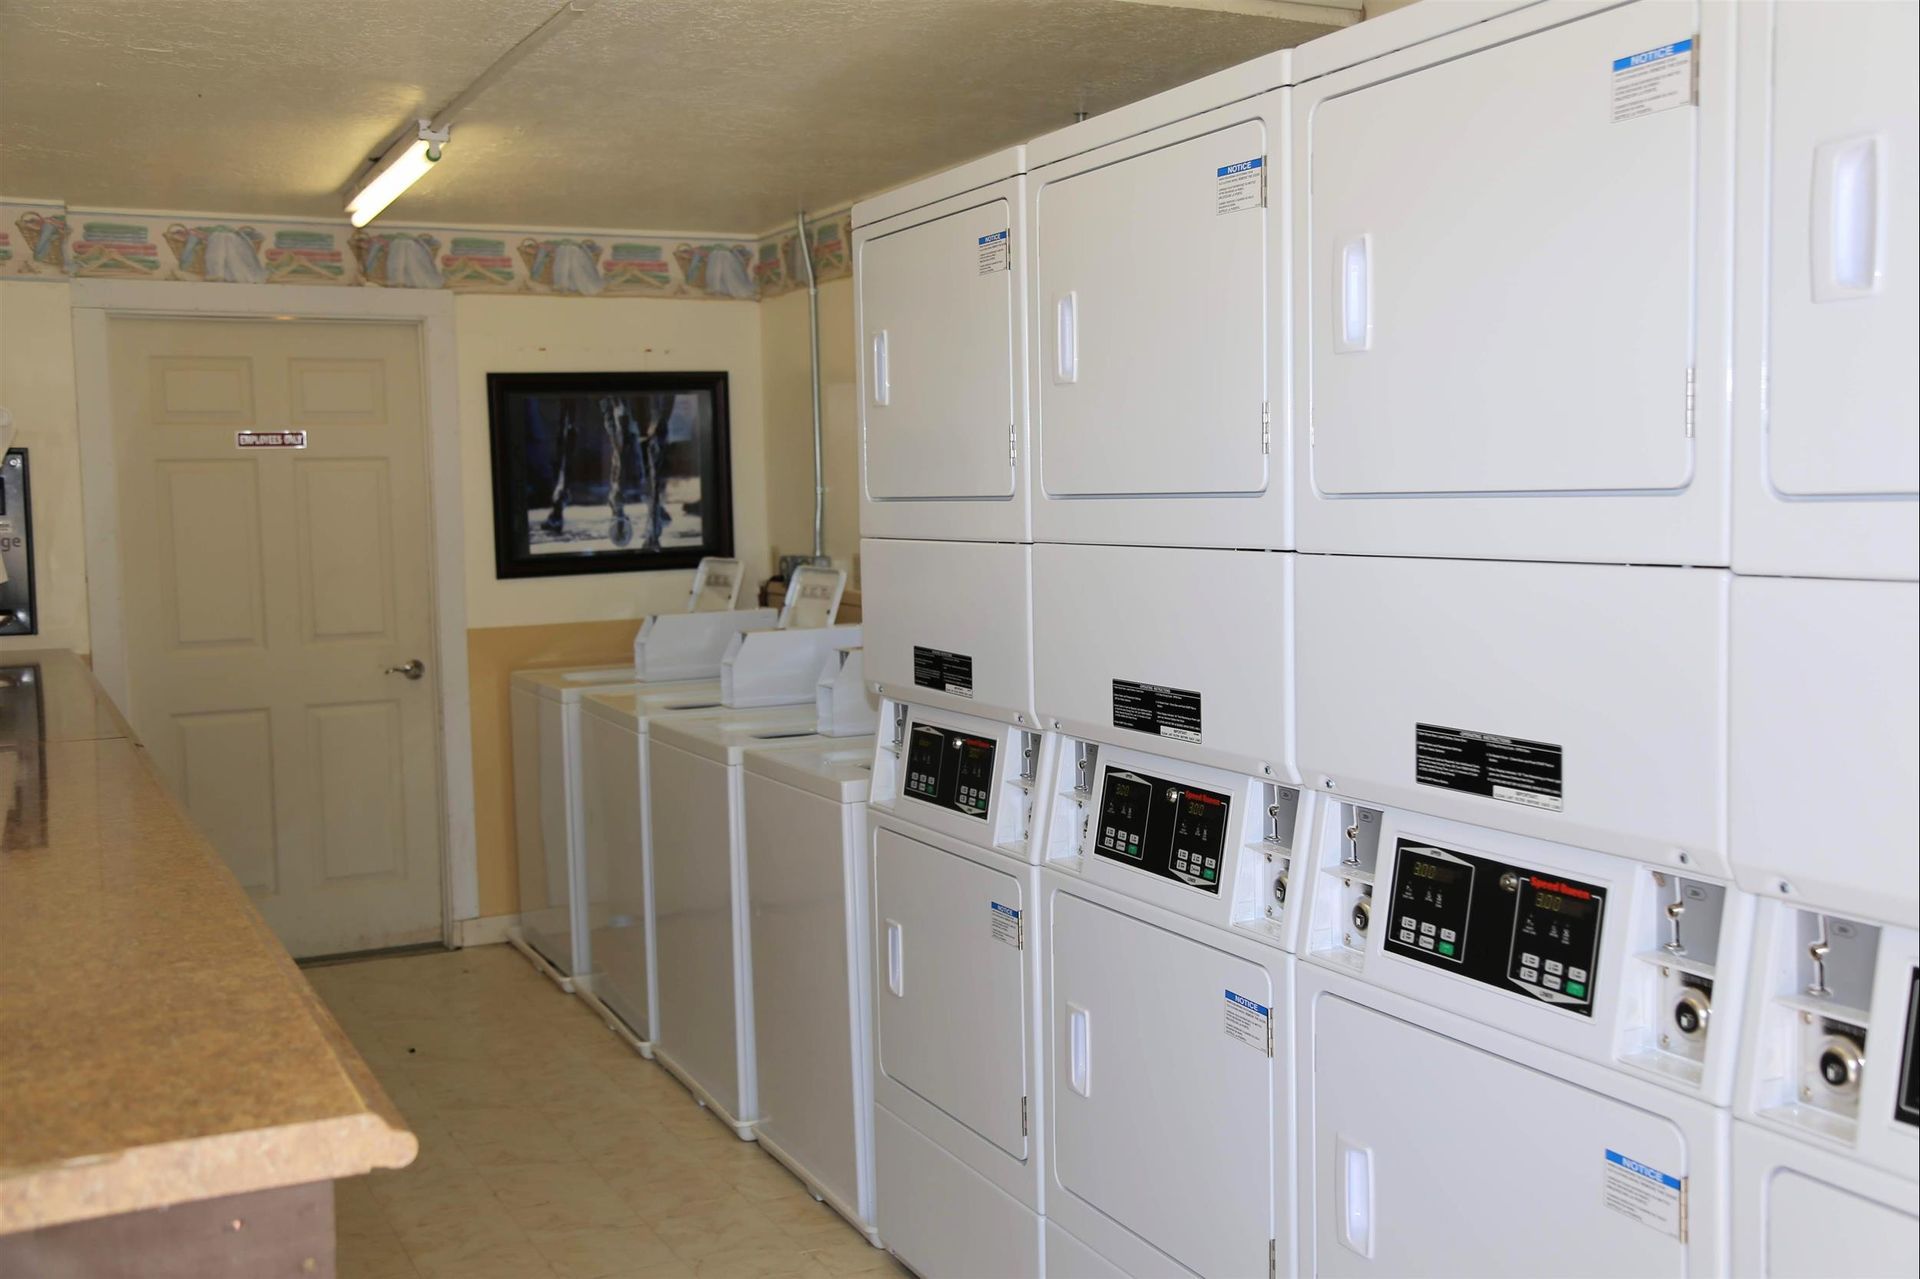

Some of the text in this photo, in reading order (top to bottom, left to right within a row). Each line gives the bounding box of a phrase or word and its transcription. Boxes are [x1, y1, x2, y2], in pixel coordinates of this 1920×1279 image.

[1630, 46, 1675, 66] NOTICE
[1227, 162, 1252, 174] NOTICE
[984, 234, 1001, 243] NOTICE
[239, 434, 303, 445] EMPLOYEES ONLY
[997, 905, 1013, 916] NOTICE
[1234, 995, 1259, 1011] NOTICE
[1621, 1157, 1664, 1182] NOTICE
